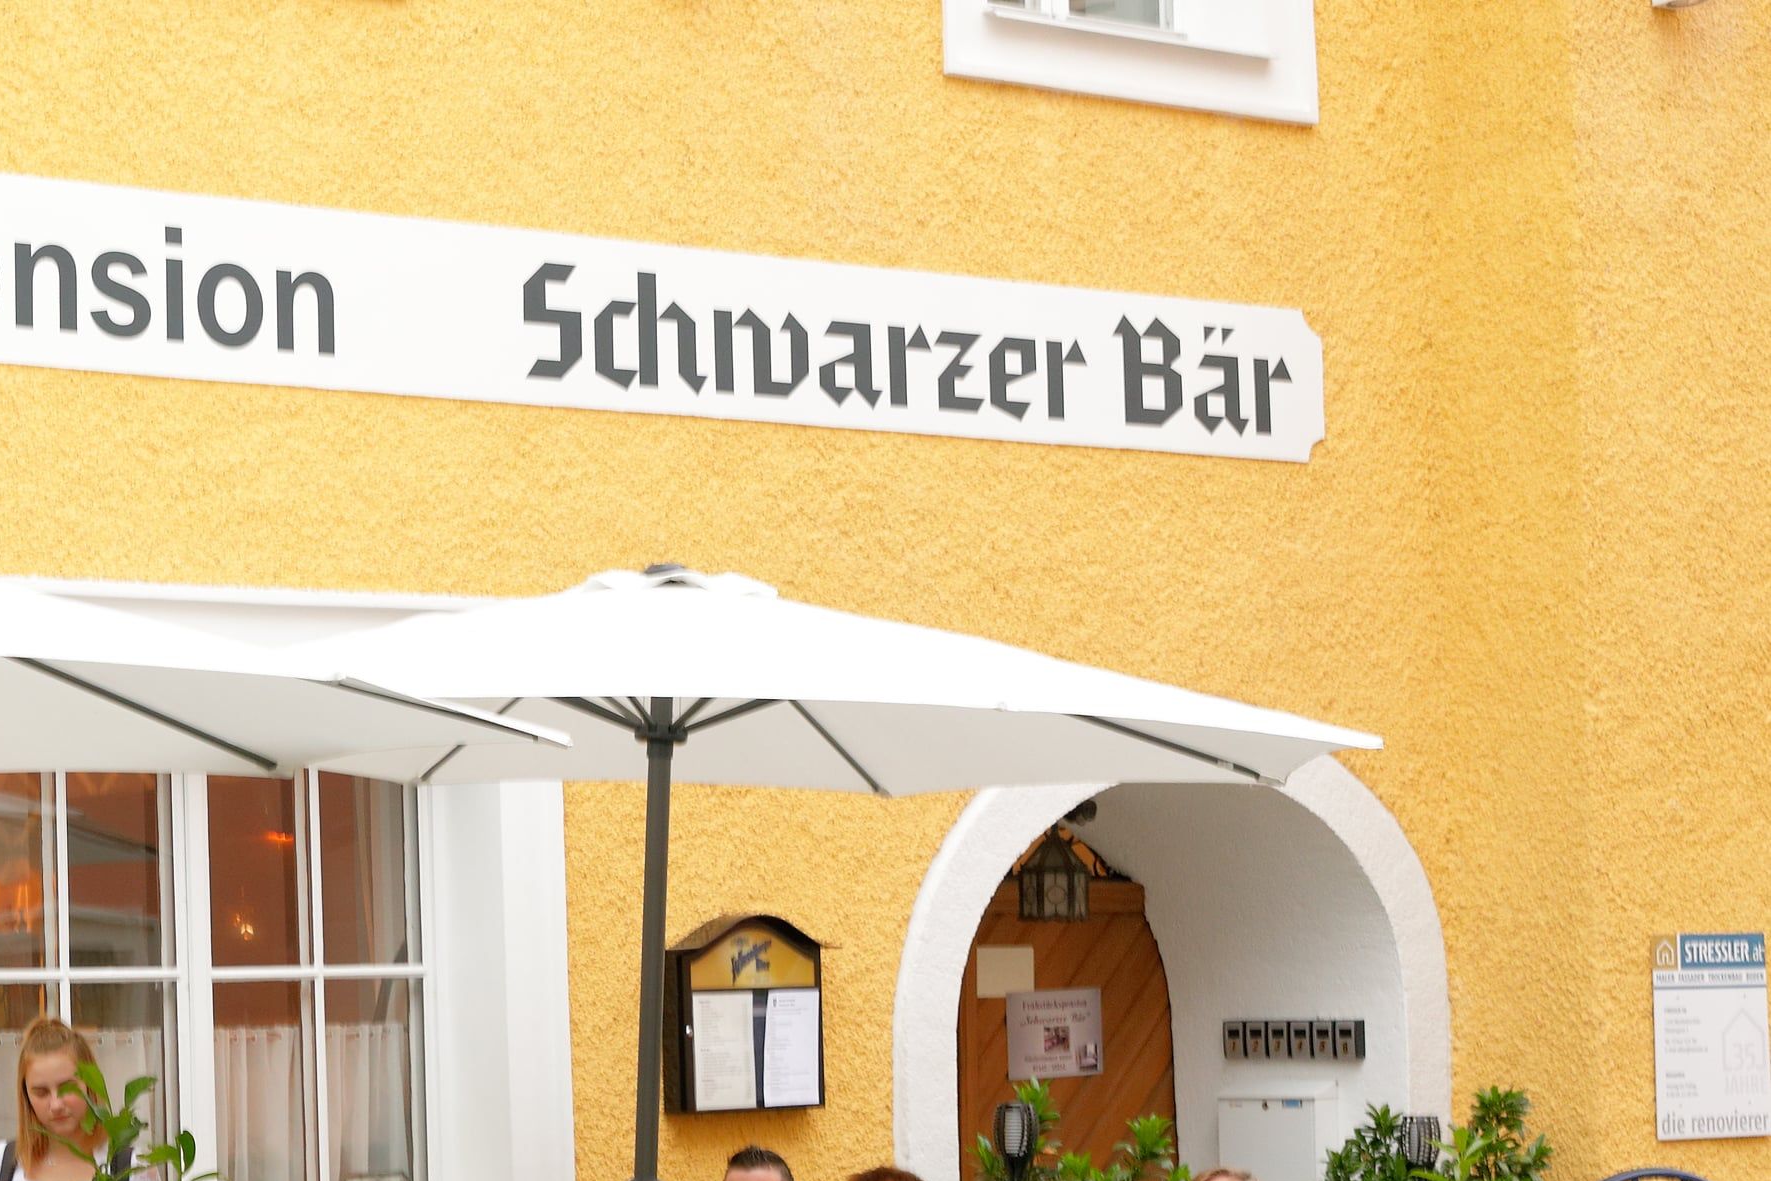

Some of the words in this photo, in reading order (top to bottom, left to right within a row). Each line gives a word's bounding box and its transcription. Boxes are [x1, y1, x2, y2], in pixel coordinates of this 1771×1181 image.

[523, 262, 1086, 422] Schwarzer
[1114, 315, 1293, 437] Bär
[1684, 940, 1750, 964] STRESSLER
[1661, 1114, 1685, 1136] die
[1691, 1110, 1769, 1134] renovierer
